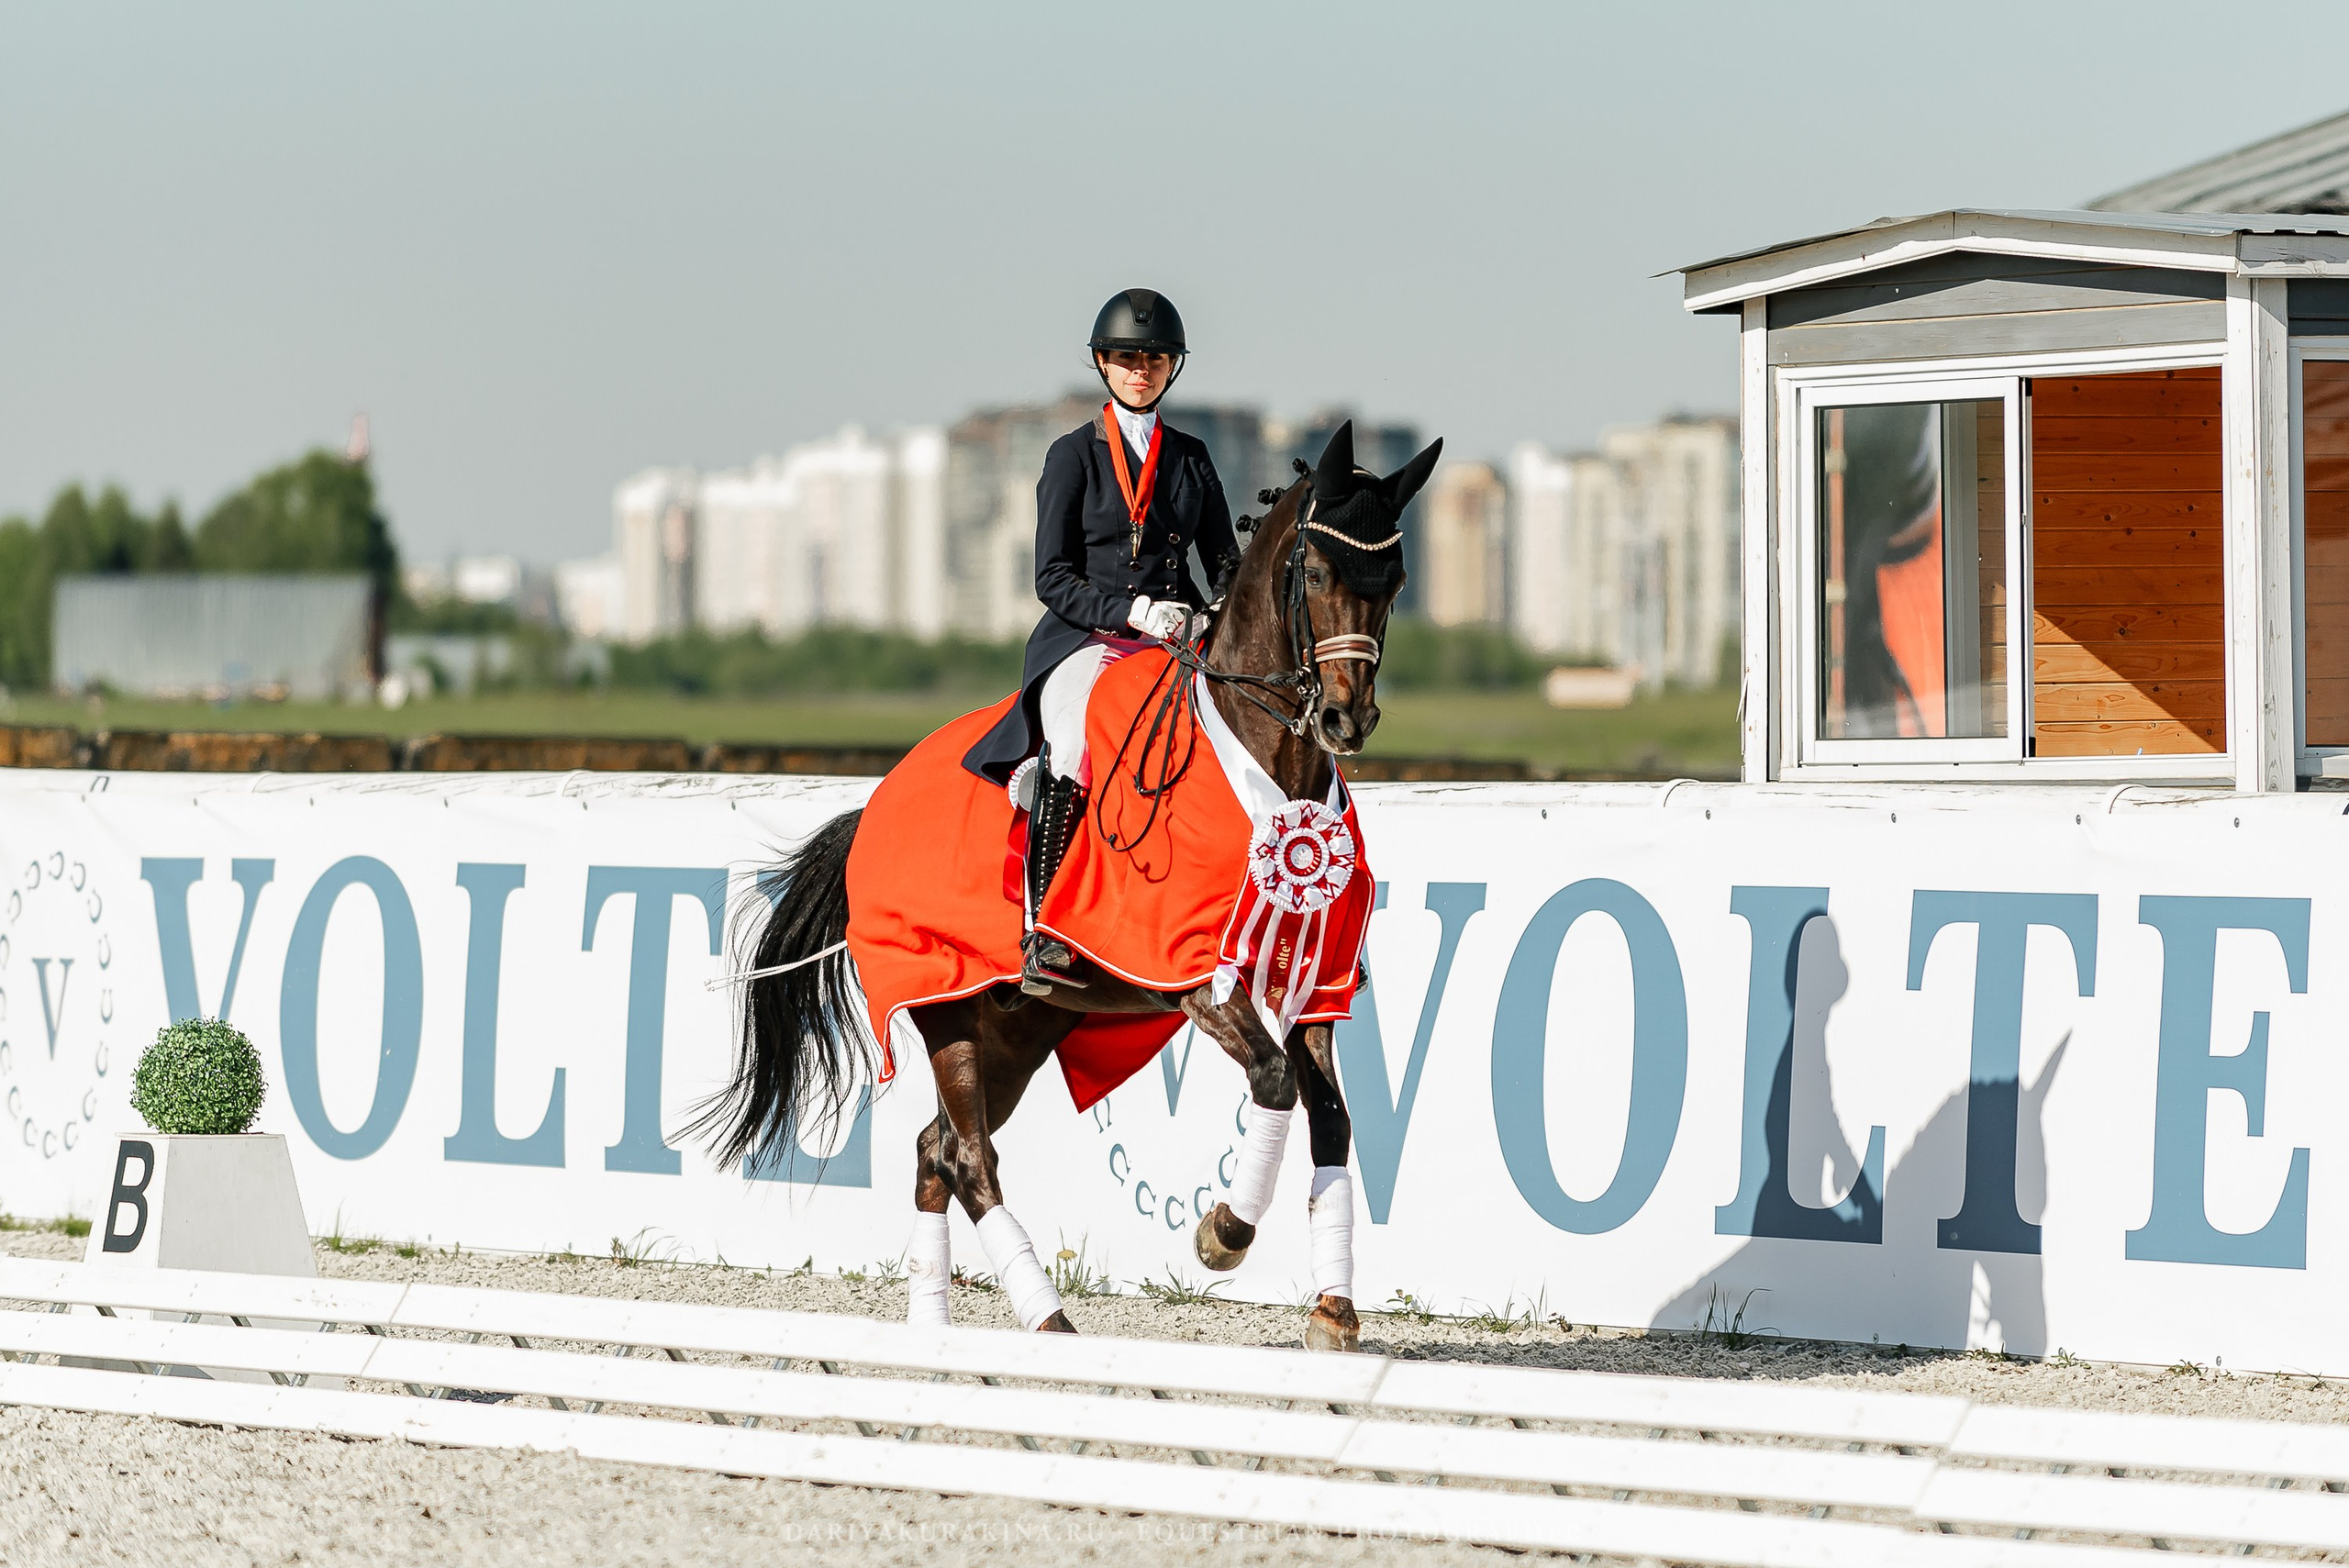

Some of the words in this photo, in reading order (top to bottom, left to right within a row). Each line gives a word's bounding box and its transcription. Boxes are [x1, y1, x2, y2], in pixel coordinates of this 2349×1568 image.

[32, 958, 74, 1061] V
[1333, 878, 2312, 1270] VOLTE
[103, 1140, 155, 1253] B
